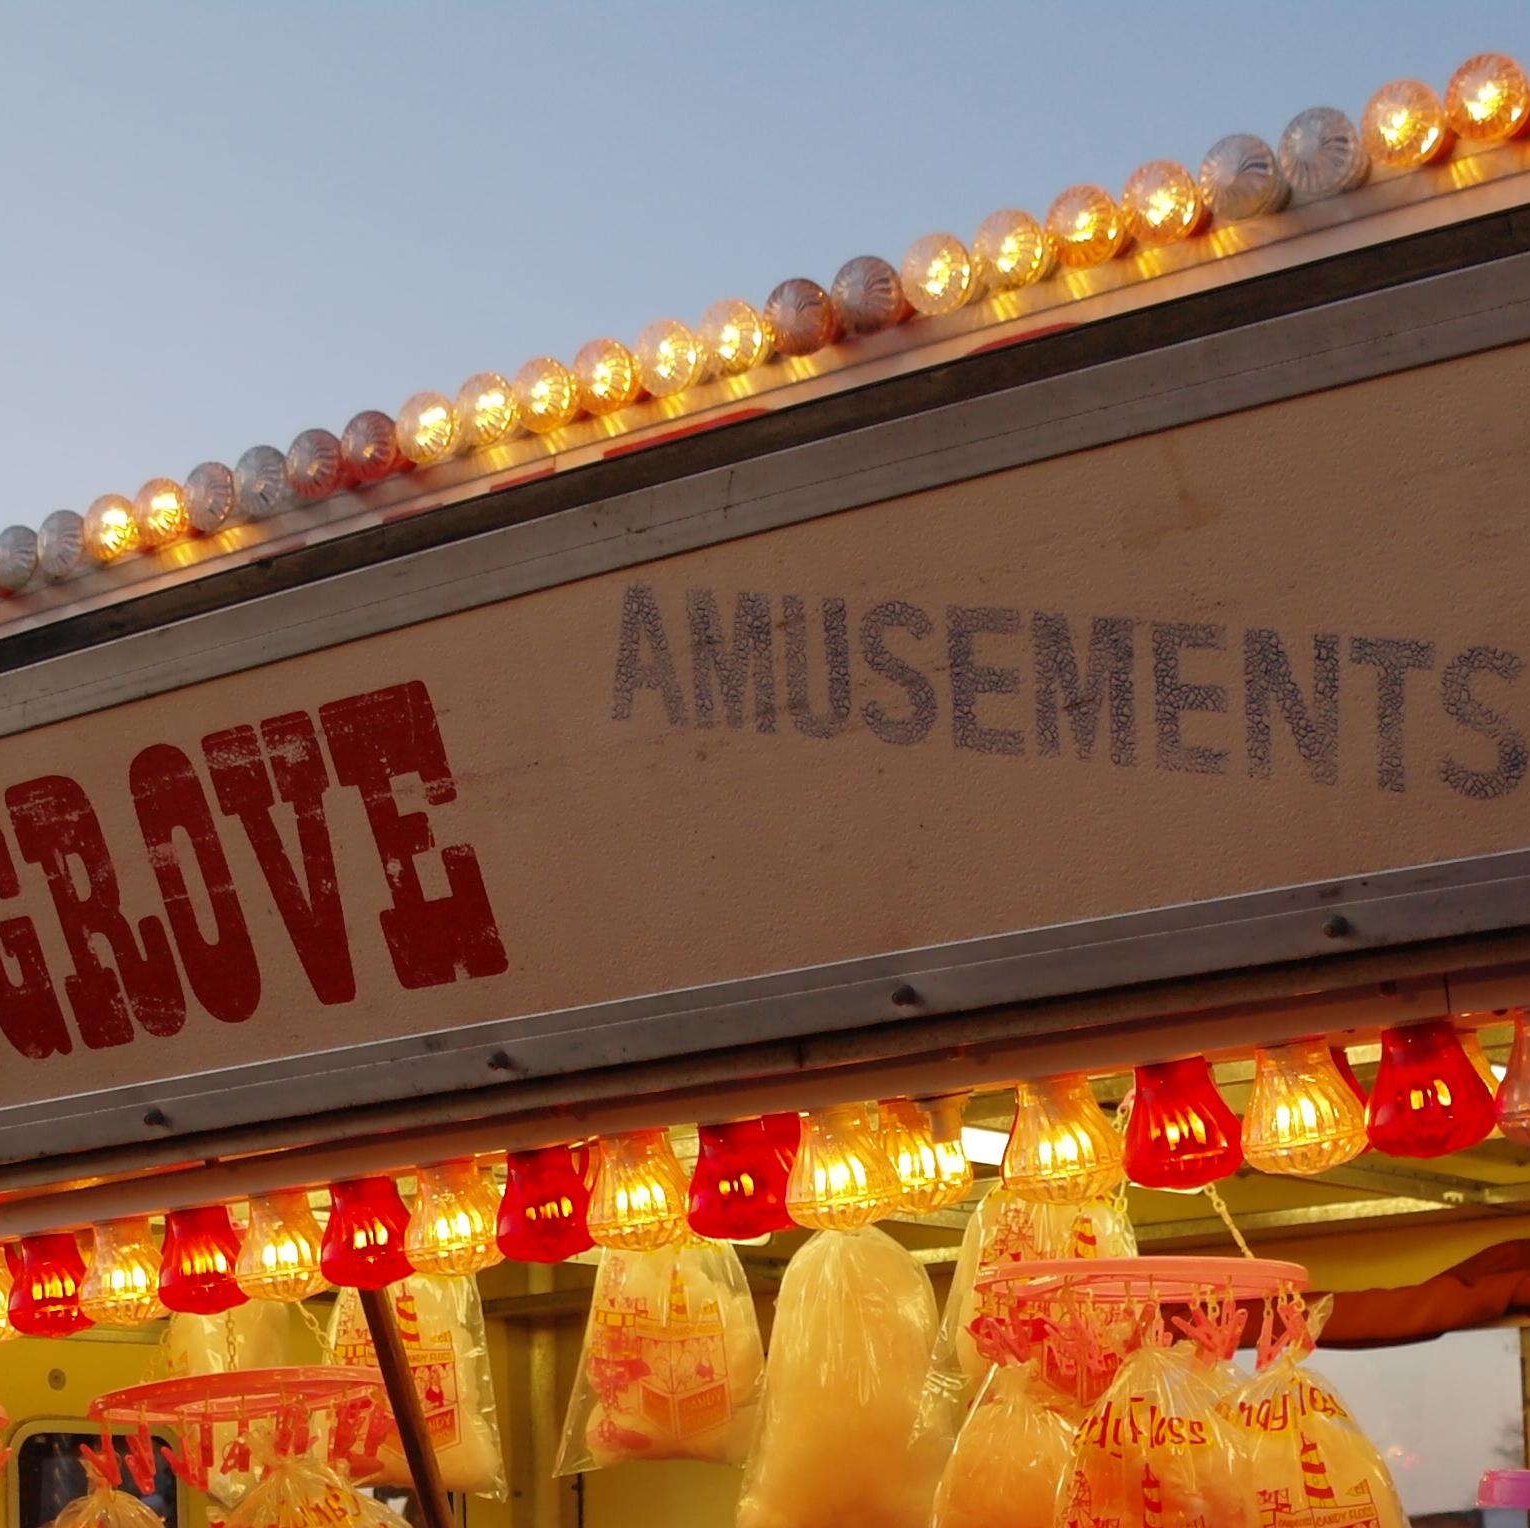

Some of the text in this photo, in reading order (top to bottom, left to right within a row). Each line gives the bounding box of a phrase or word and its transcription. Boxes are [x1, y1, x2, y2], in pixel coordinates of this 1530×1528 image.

[610, 581, 1530, 802] AMUSEMENTS
[1317, 1511, 1343, 1528] CANDY
[1345, 1506, 1375, 1522] FLOSS
